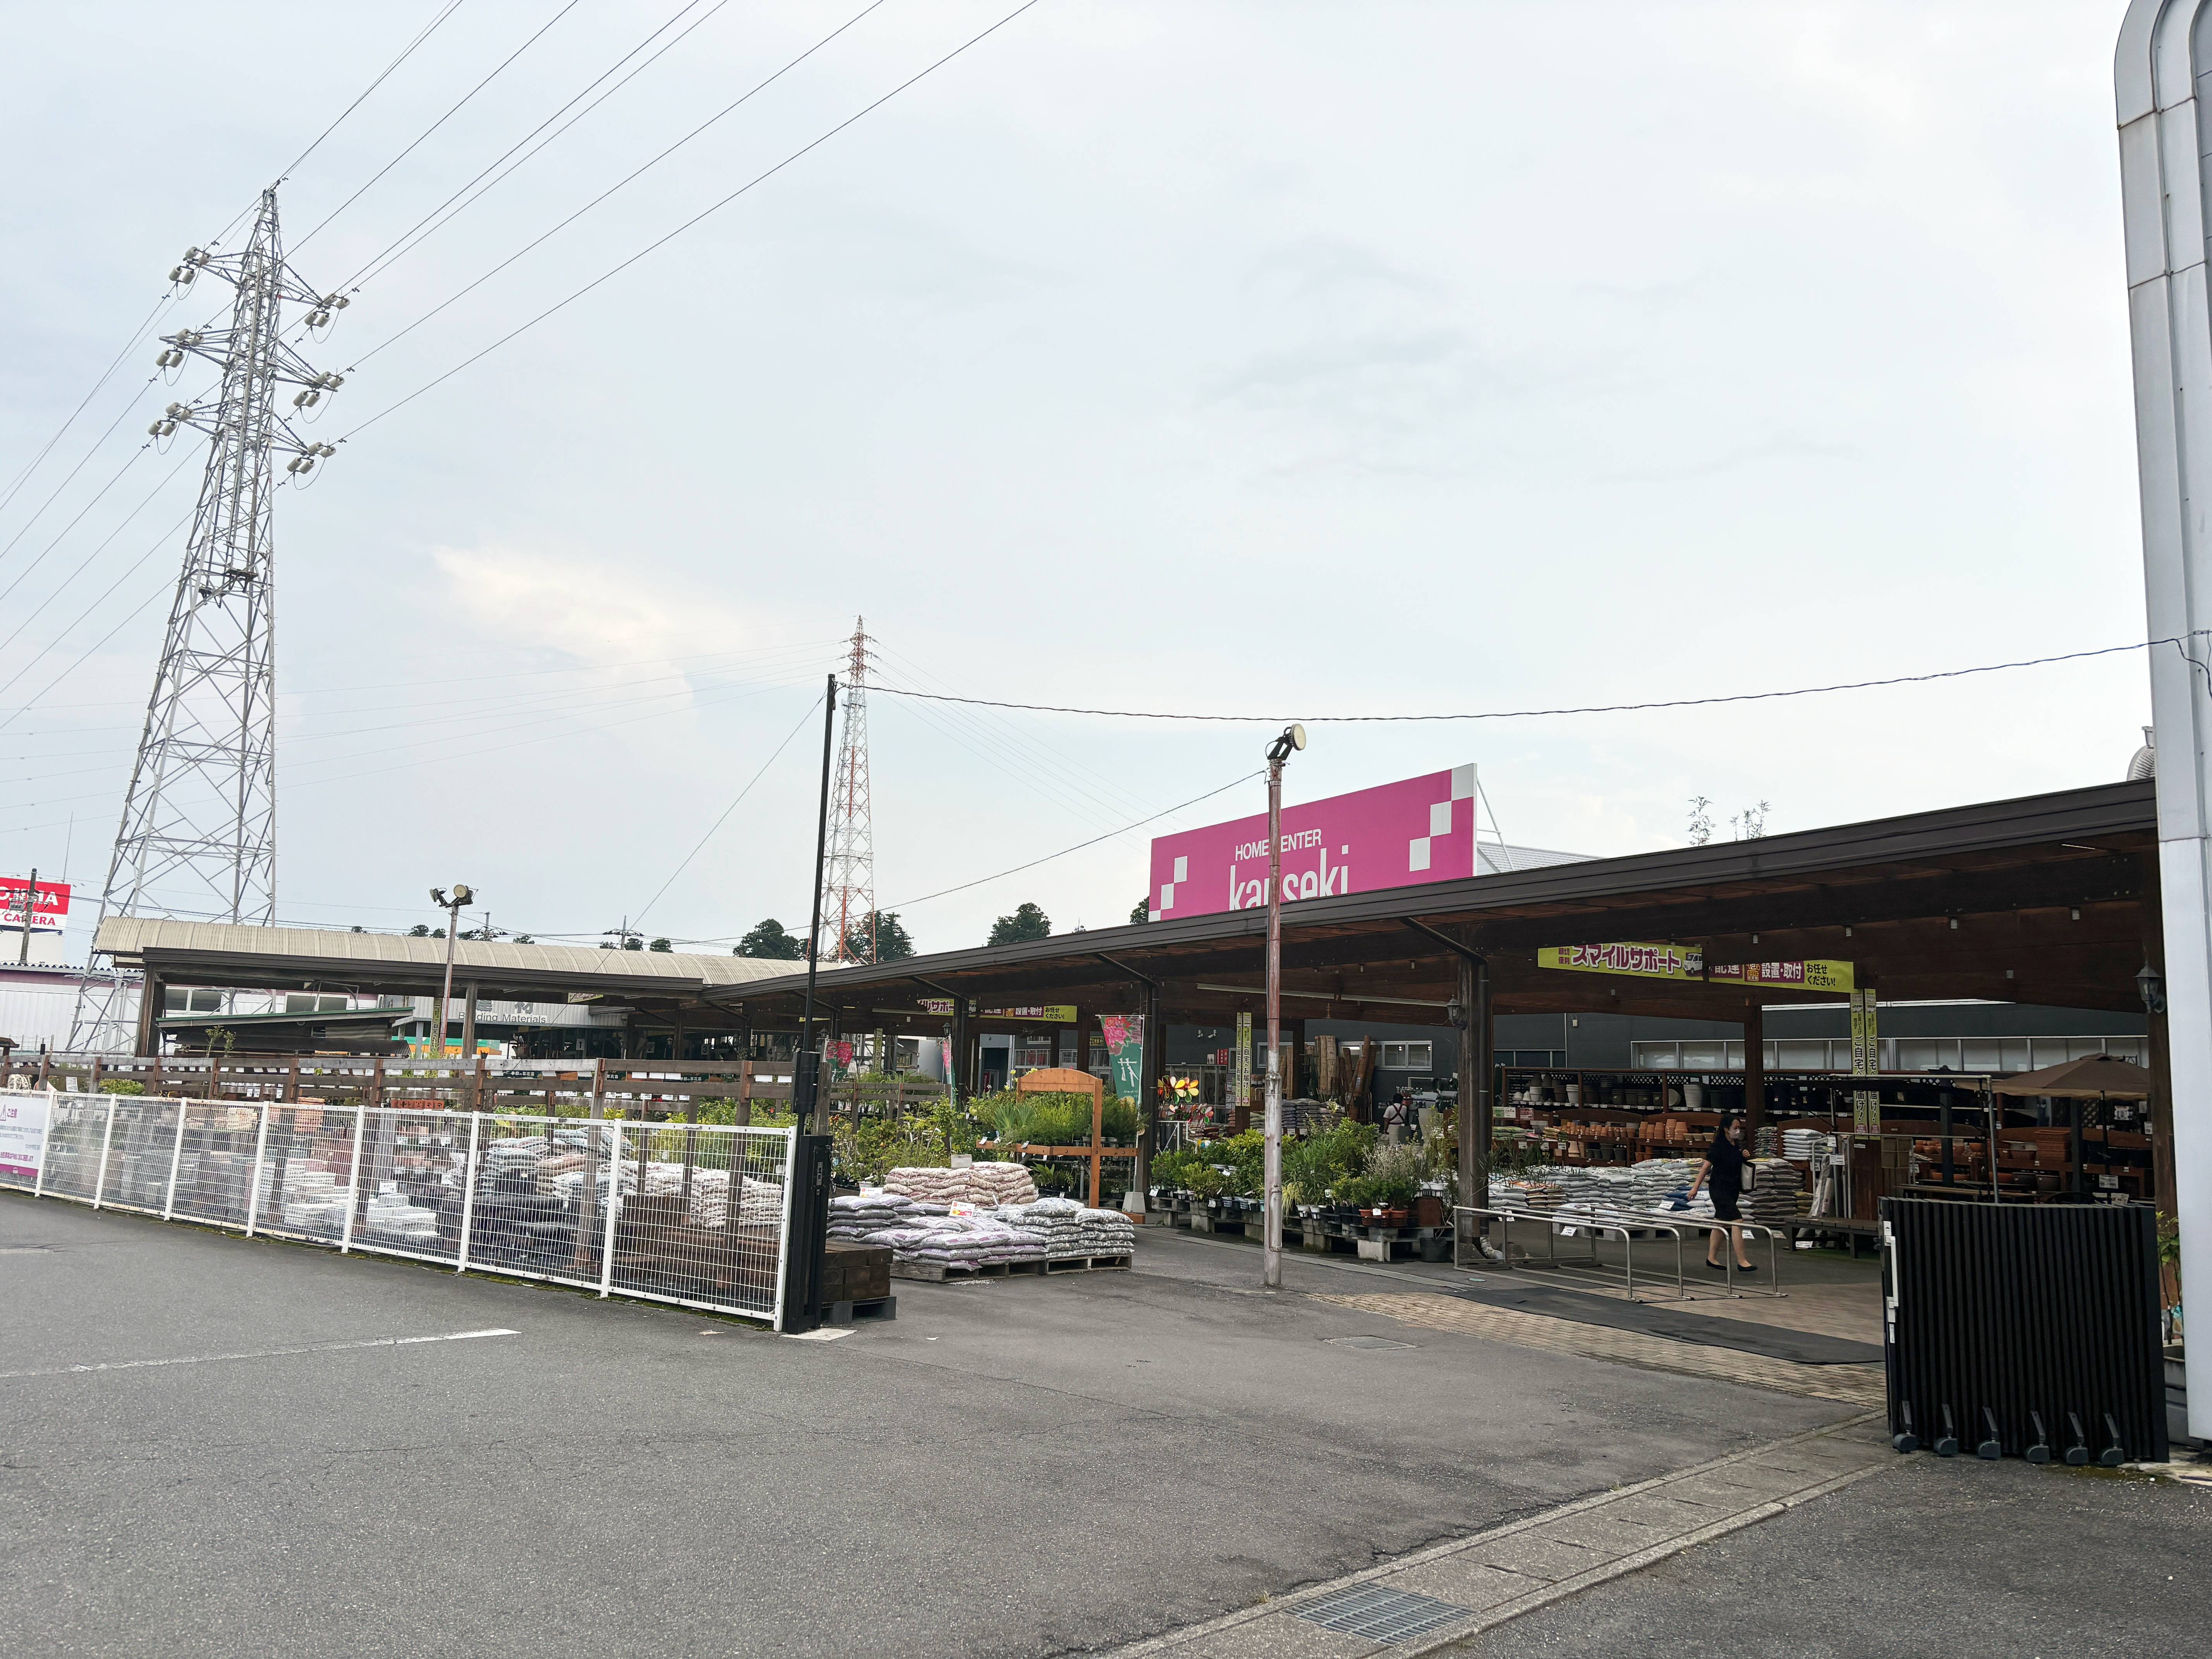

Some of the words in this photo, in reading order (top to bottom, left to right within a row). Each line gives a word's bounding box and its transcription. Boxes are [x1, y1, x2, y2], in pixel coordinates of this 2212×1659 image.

[1235, 838, 1269, 861] HOME
[1279, 828, 1321, 853] ENTER
[4, 913, 56, 926] CAERA
[1571, 944, 1681, 974] スマイルサポート
[1806, 963, 1827, 974] お任せ
[502, 1014, 546, 1024] Materials
